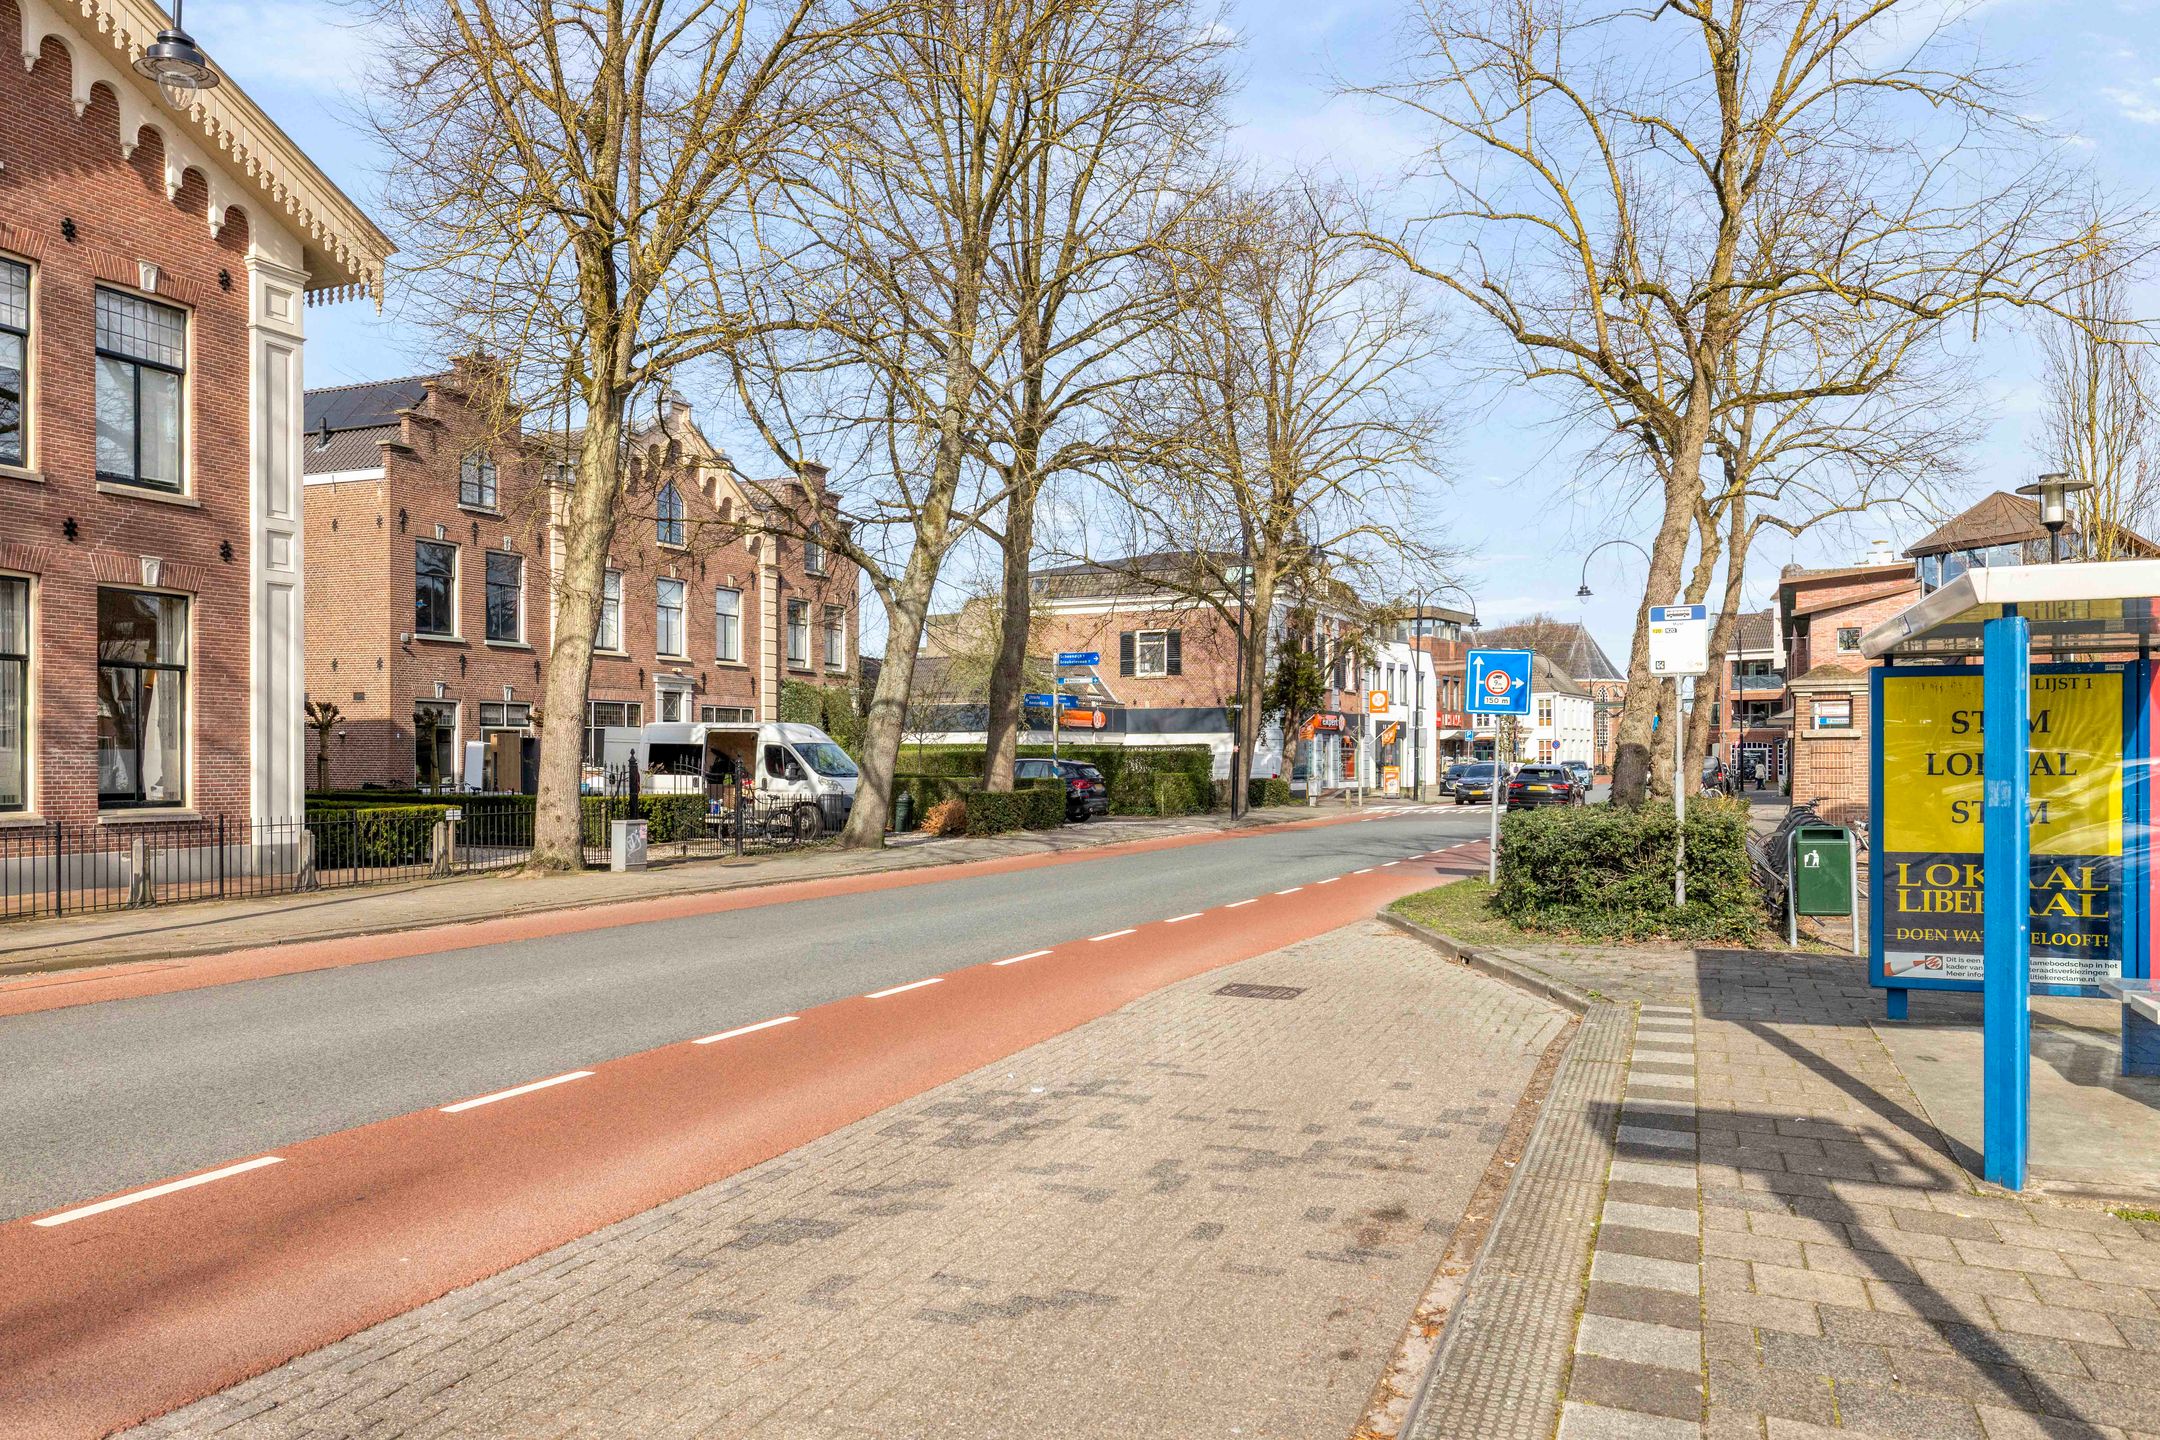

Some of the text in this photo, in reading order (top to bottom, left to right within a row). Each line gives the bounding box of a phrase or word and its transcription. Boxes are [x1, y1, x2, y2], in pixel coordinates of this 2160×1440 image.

[2034, 678, 2092, 692] LIJST 1
[1951, 709, 2050, 734] STM
[1925, 752, 2077, 776] LOAL
[1951, 800, 2050, 824] STM
[1896, 863, 2108, 891] LOKAL
[1896, 888, 2108, 918] LIBEAL
[1896, 928, 1948, 941] DOEN
[2030, 931, 2109, 947] ELOOFT!
[2030, 960, 2094, 969] lameboodschap
[2030, 974, 2096, 983] litiekereclame.nl
